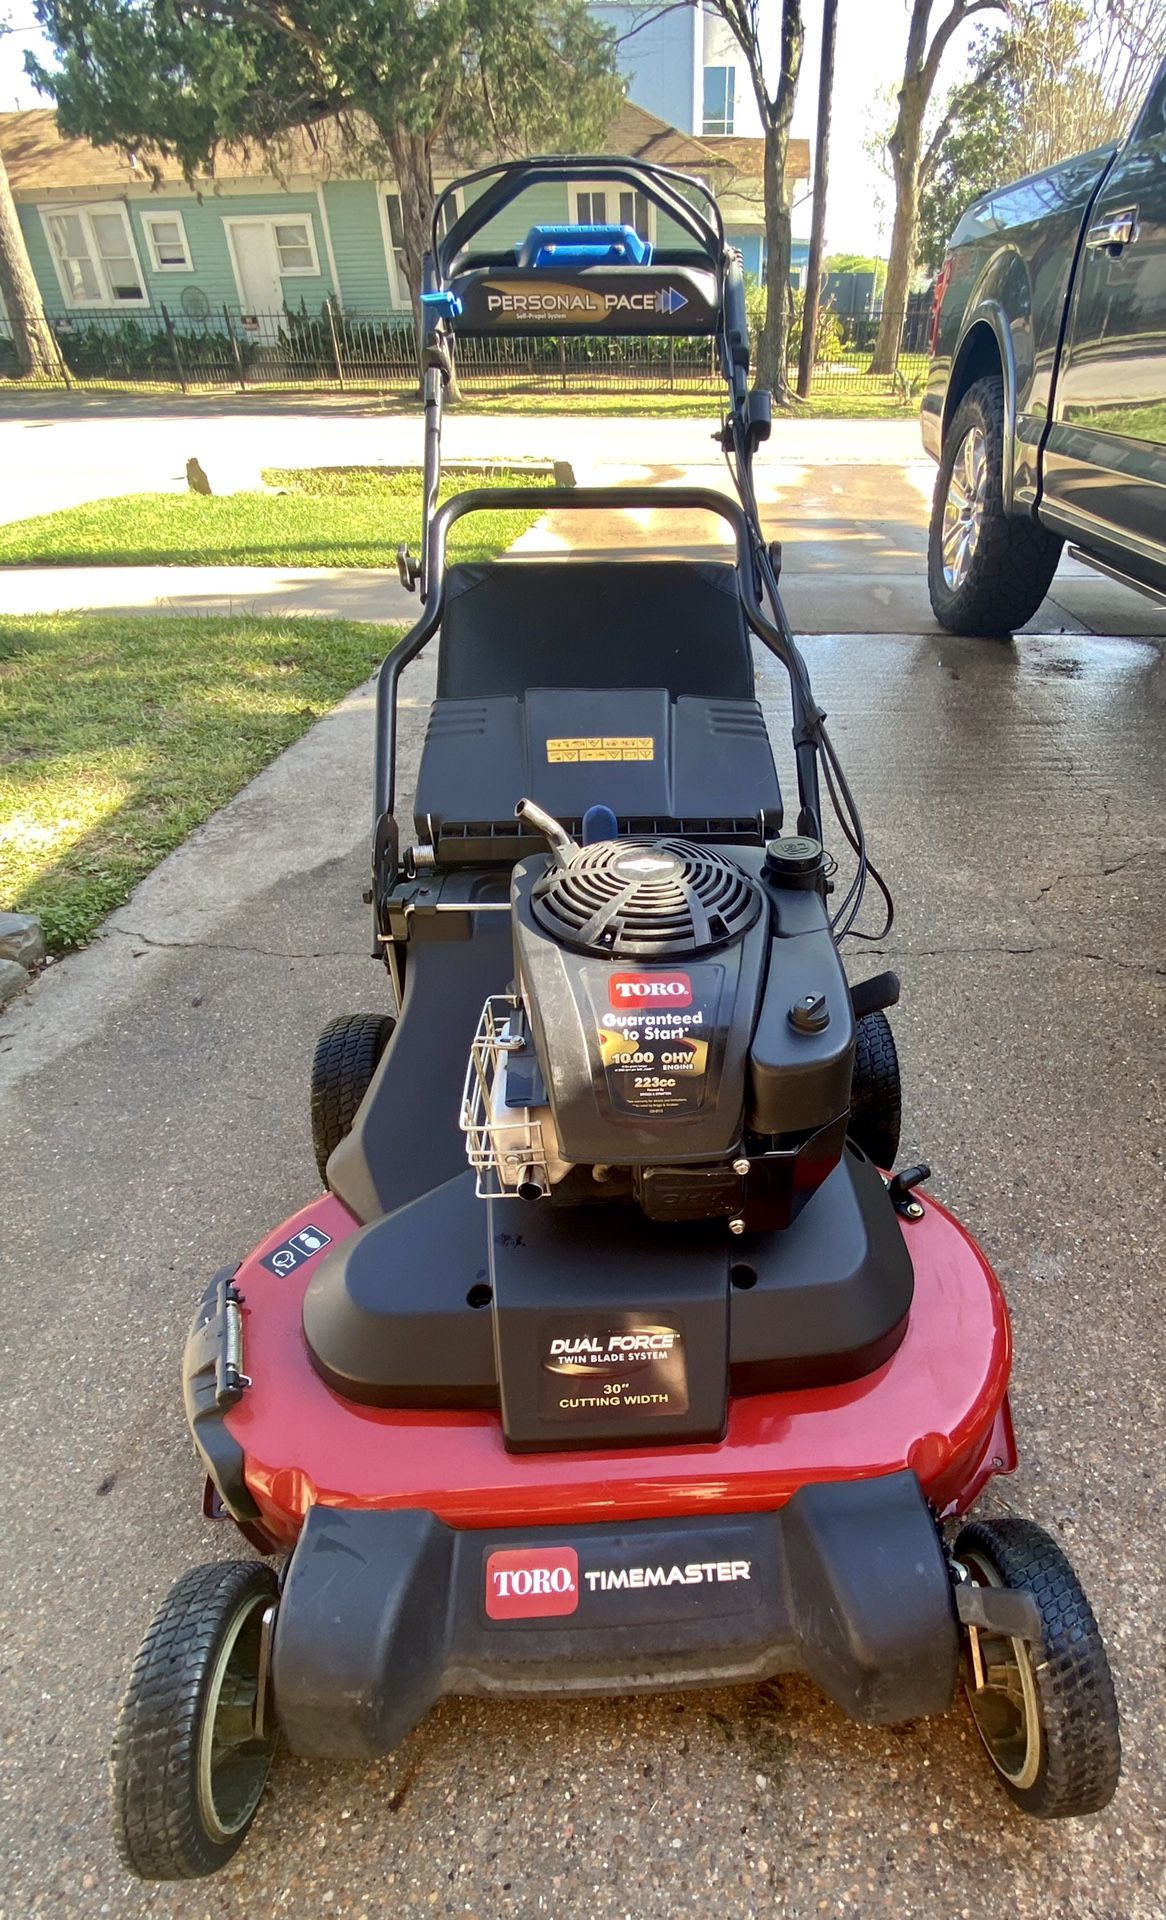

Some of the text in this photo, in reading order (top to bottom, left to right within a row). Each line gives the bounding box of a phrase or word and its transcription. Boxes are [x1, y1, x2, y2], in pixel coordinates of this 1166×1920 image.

[487, 293, 656, 311] PERSONAL PACE
[602, 1011, 702, 1027] Guaranteed
[623, 1028, 640, 1041] to
[611, 1052, 694, 1064] 10.00 OHV
[634, 1077, 676, 1088] 223cc
[550, 1338, 603, 1355] DUAL
[558, 1350, 668, 1364] TWIN BLADE SYSTEM
[559, 1393, 669, 1408] CUTTING WIDTH
[584, 1560, 752, 1591] TIMEMASTER
